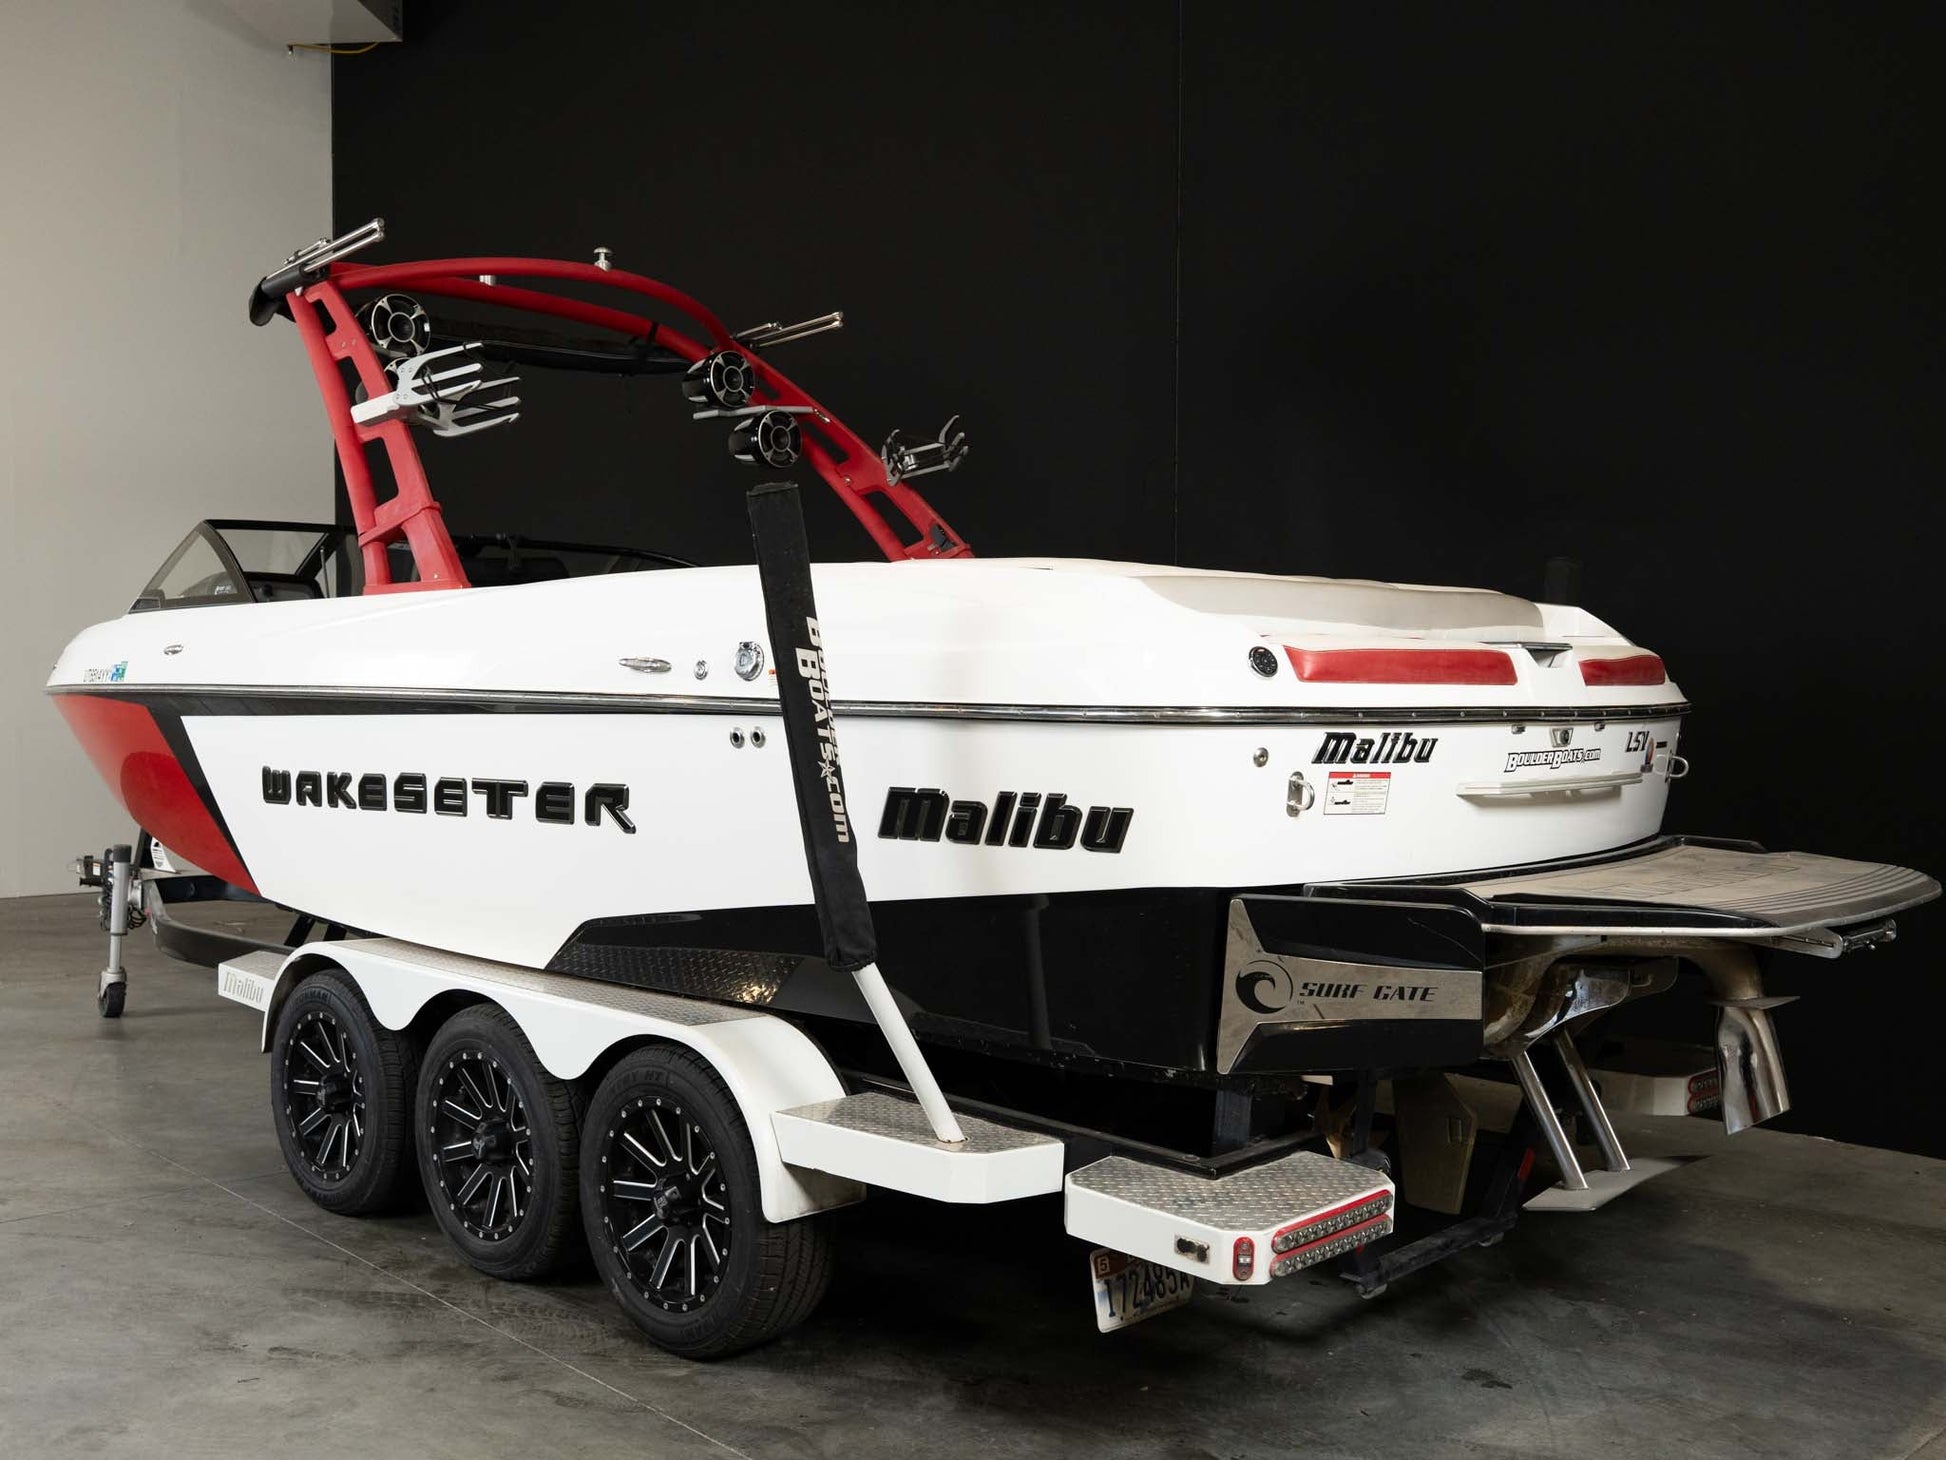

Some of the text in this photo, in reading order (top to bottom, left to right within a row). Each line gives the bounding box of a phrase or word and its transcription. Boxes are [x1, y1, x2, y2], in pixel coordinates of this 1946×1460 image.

[1311, 732, 1439, 764] Malibu
[1625, 731, 1650, 753] LSV
[262, 766, 637, 834] WAKESETTER
[878, 787, 1135, 854] Malibu
[223, 971, 264, 1003] Malibu
[1299, 982, 1439, 1003] SURF GATE
